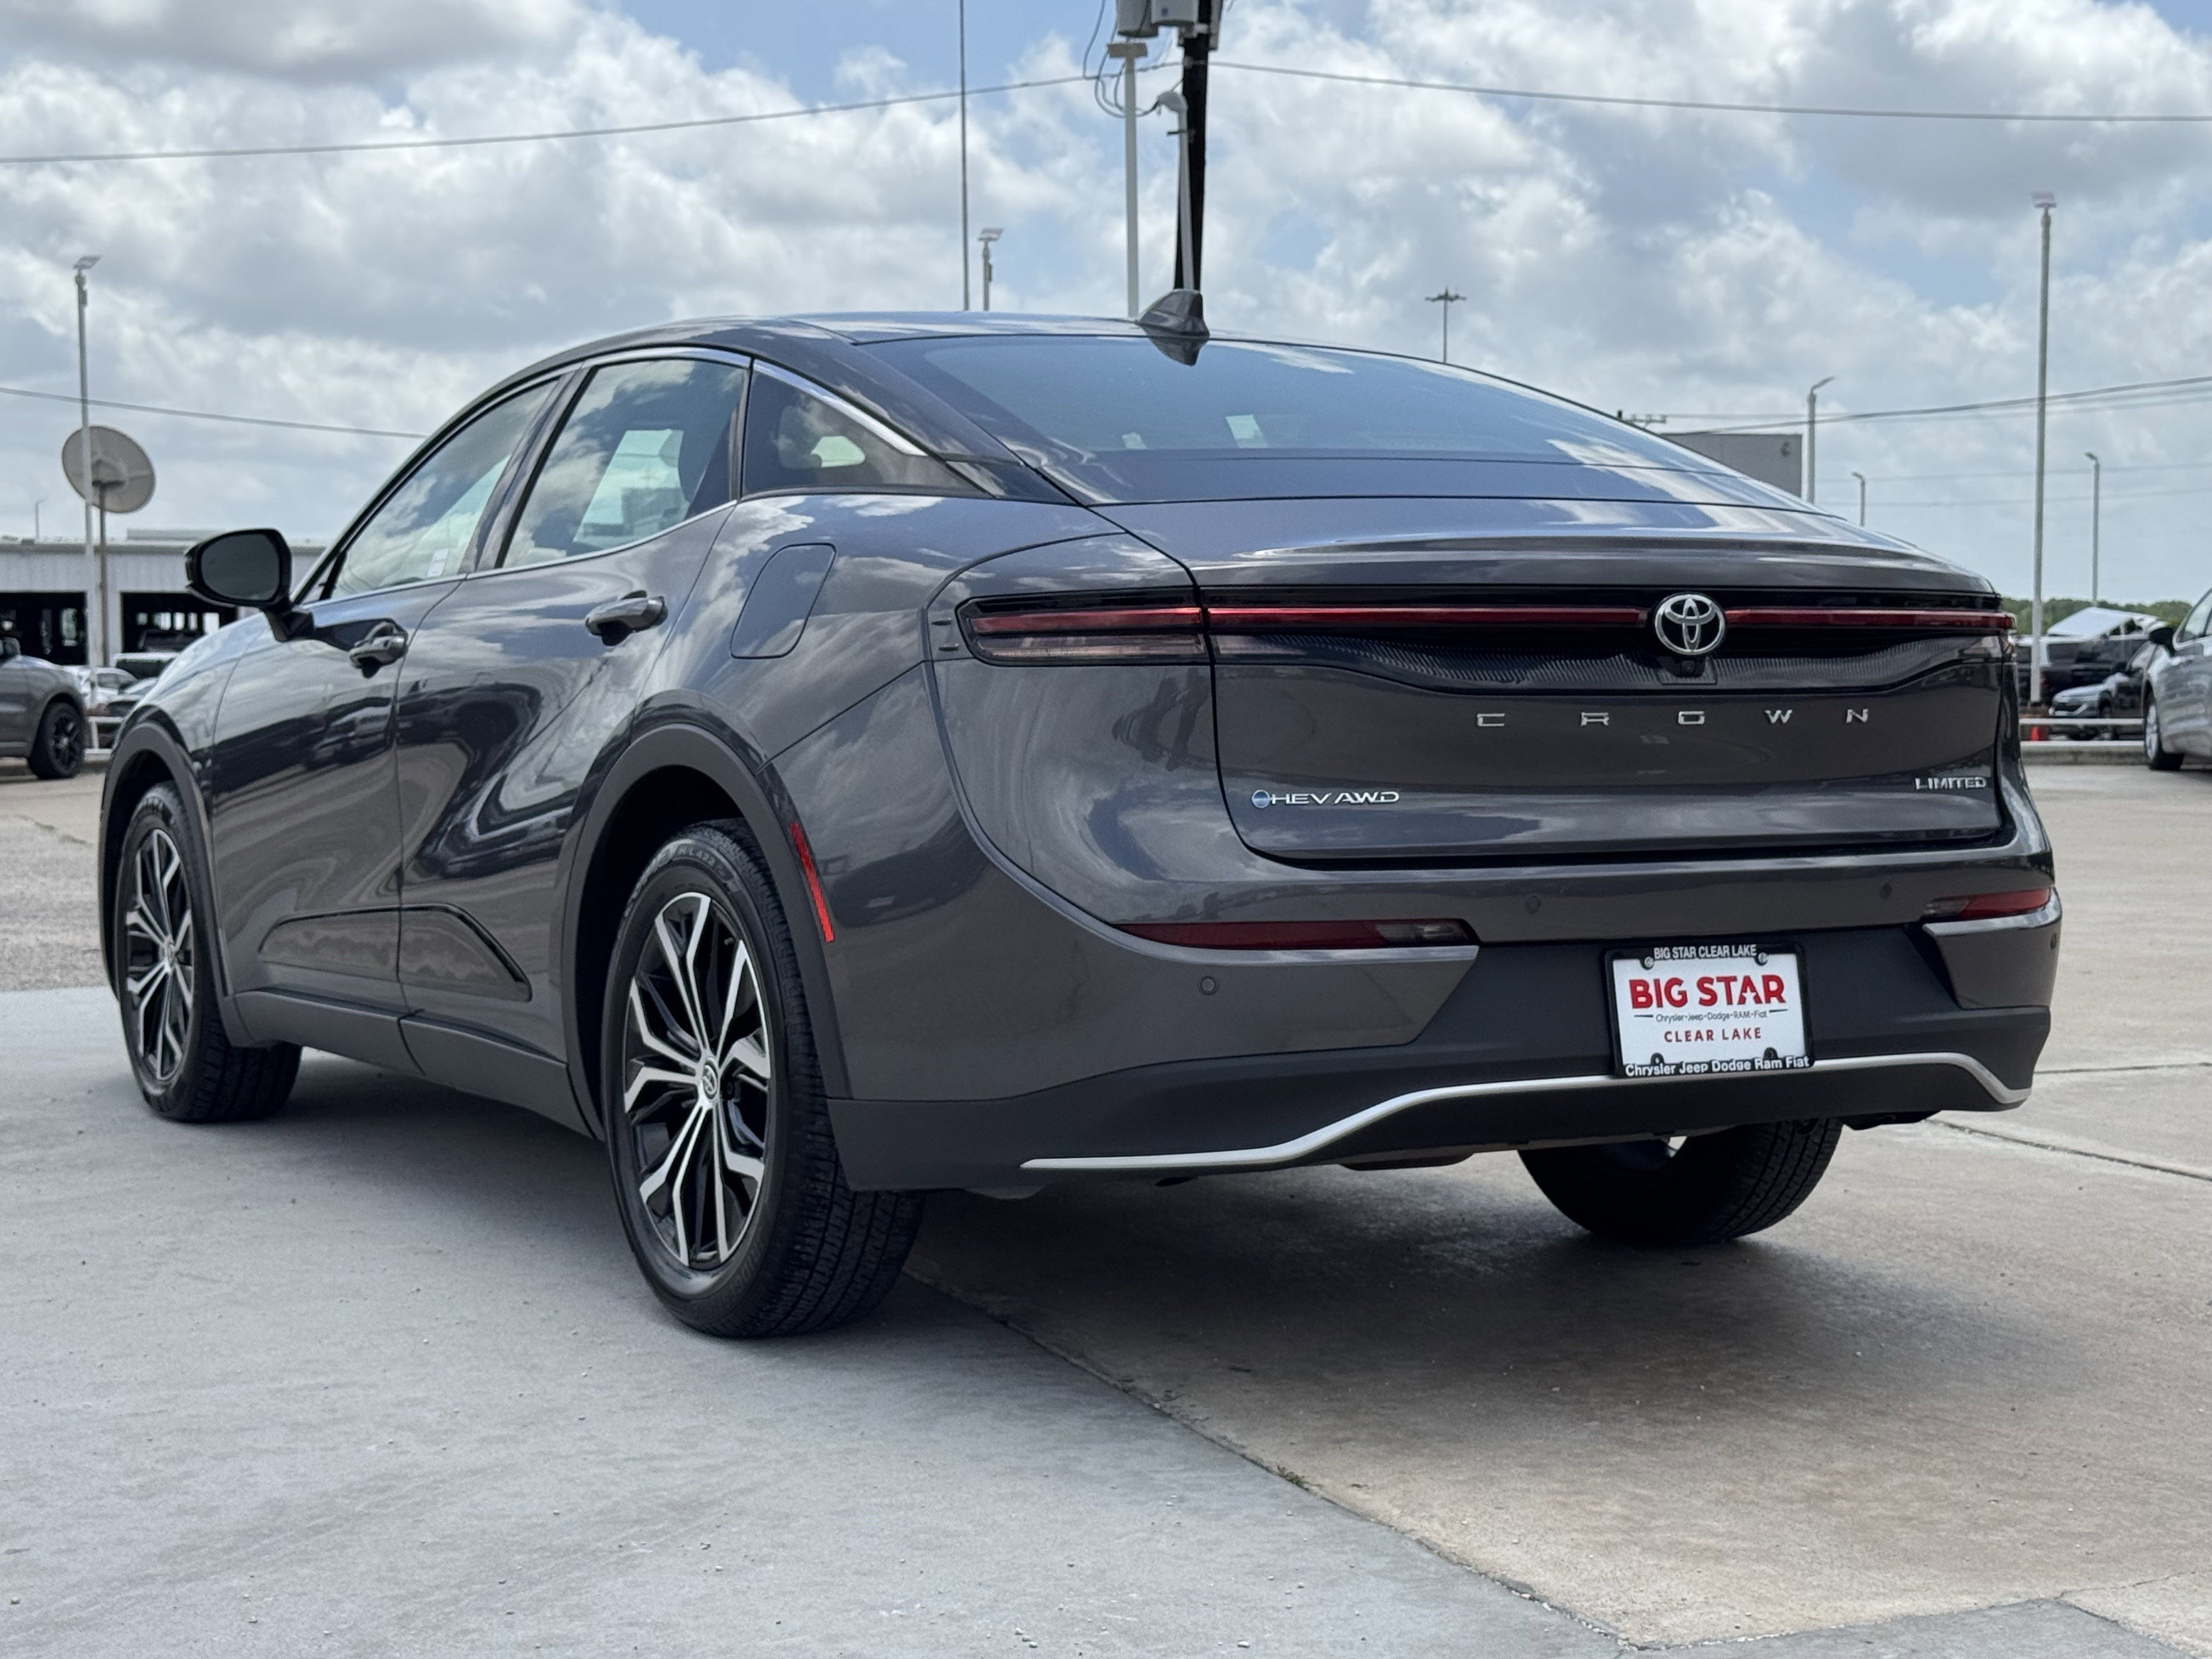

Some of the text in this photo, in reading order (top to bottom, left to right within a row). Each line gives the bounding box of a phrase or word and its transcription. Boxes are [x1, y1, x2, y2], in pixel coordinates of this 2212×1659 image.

[1476, 708, 1869, 727] CROWN
[1915, 776, 1987, 790] LIMITED
[1271, 791, 1400, 805] HEV AWD
[1654, 944, 1757, 959] BIG STAR CLEAR LAKE
[1628, 974, 1786, 1009] BIG STAR
[1663, 1026, 1762, 1043] CLEAR LAKE
[1625, 1055, 1810, 1077] Chrysler Jeep Dodge Ram Fiat
